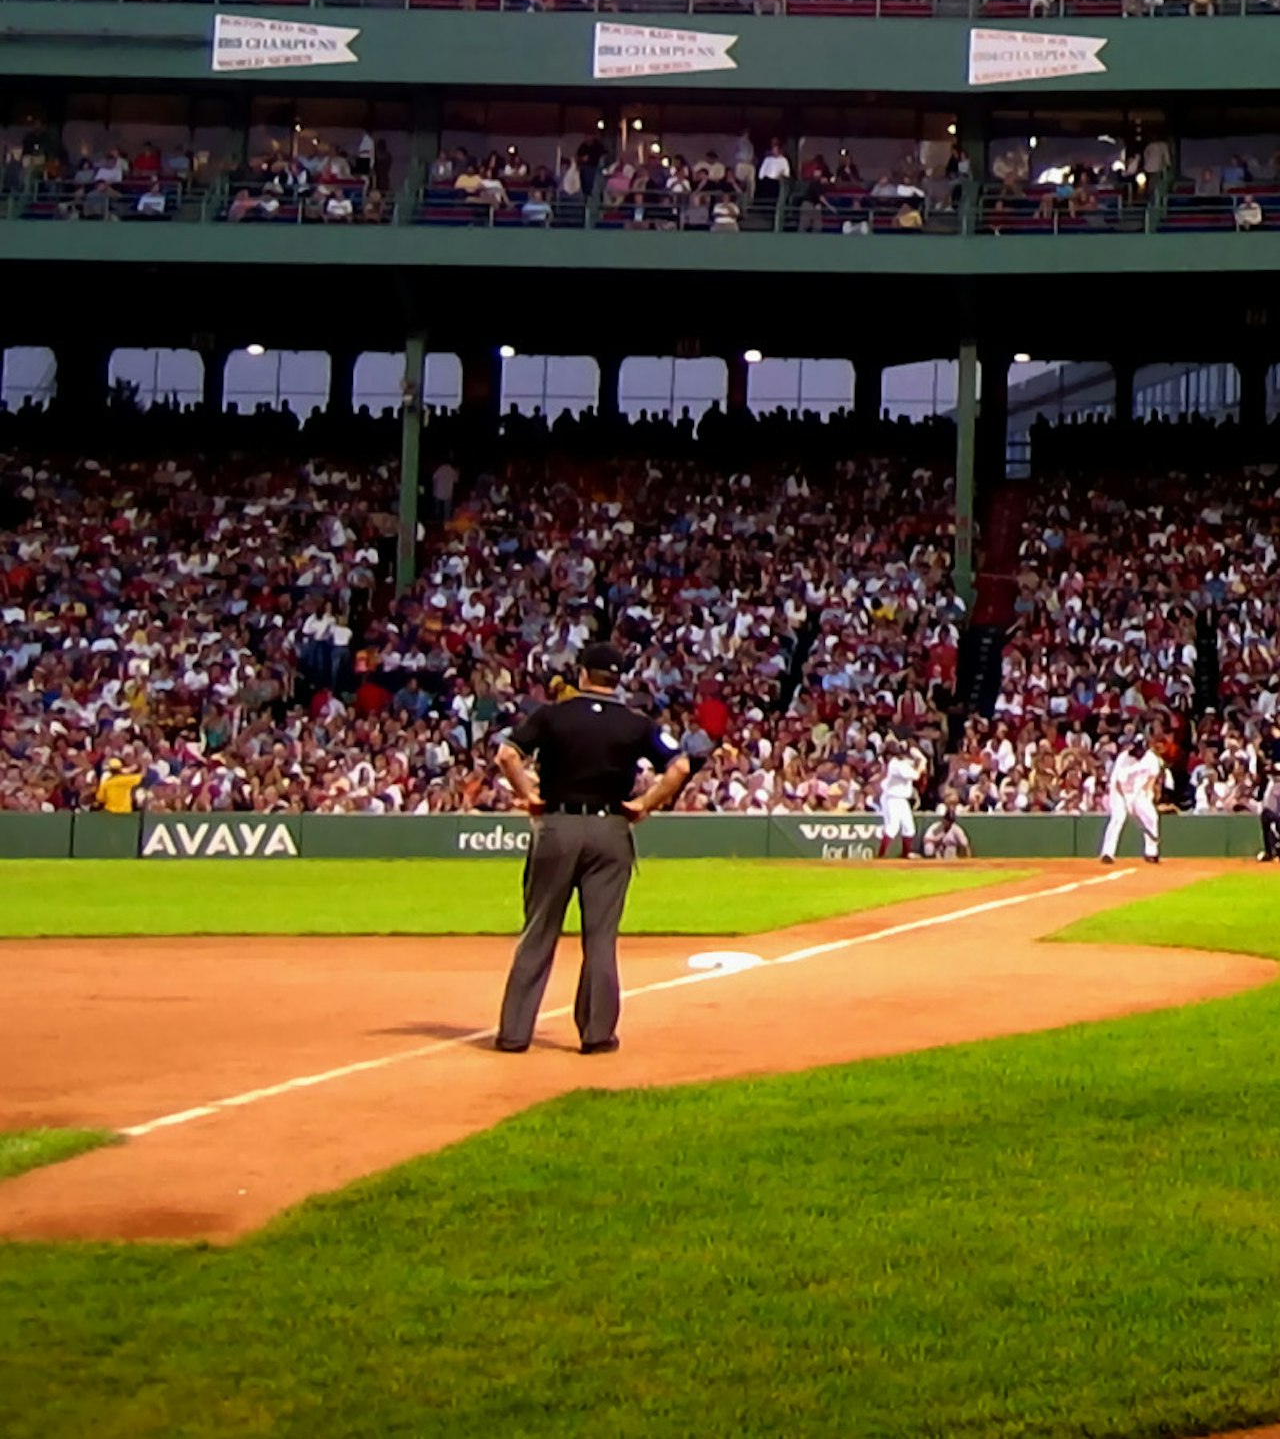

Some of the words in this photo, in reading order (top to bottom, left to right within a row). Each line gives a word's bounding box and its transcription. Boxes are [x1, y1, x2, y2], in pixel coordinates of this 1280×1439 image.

[142, 823, 298, 856] AVAYA
[458, 826, 531, 851] redso
[822, 842, 845, 860] for
